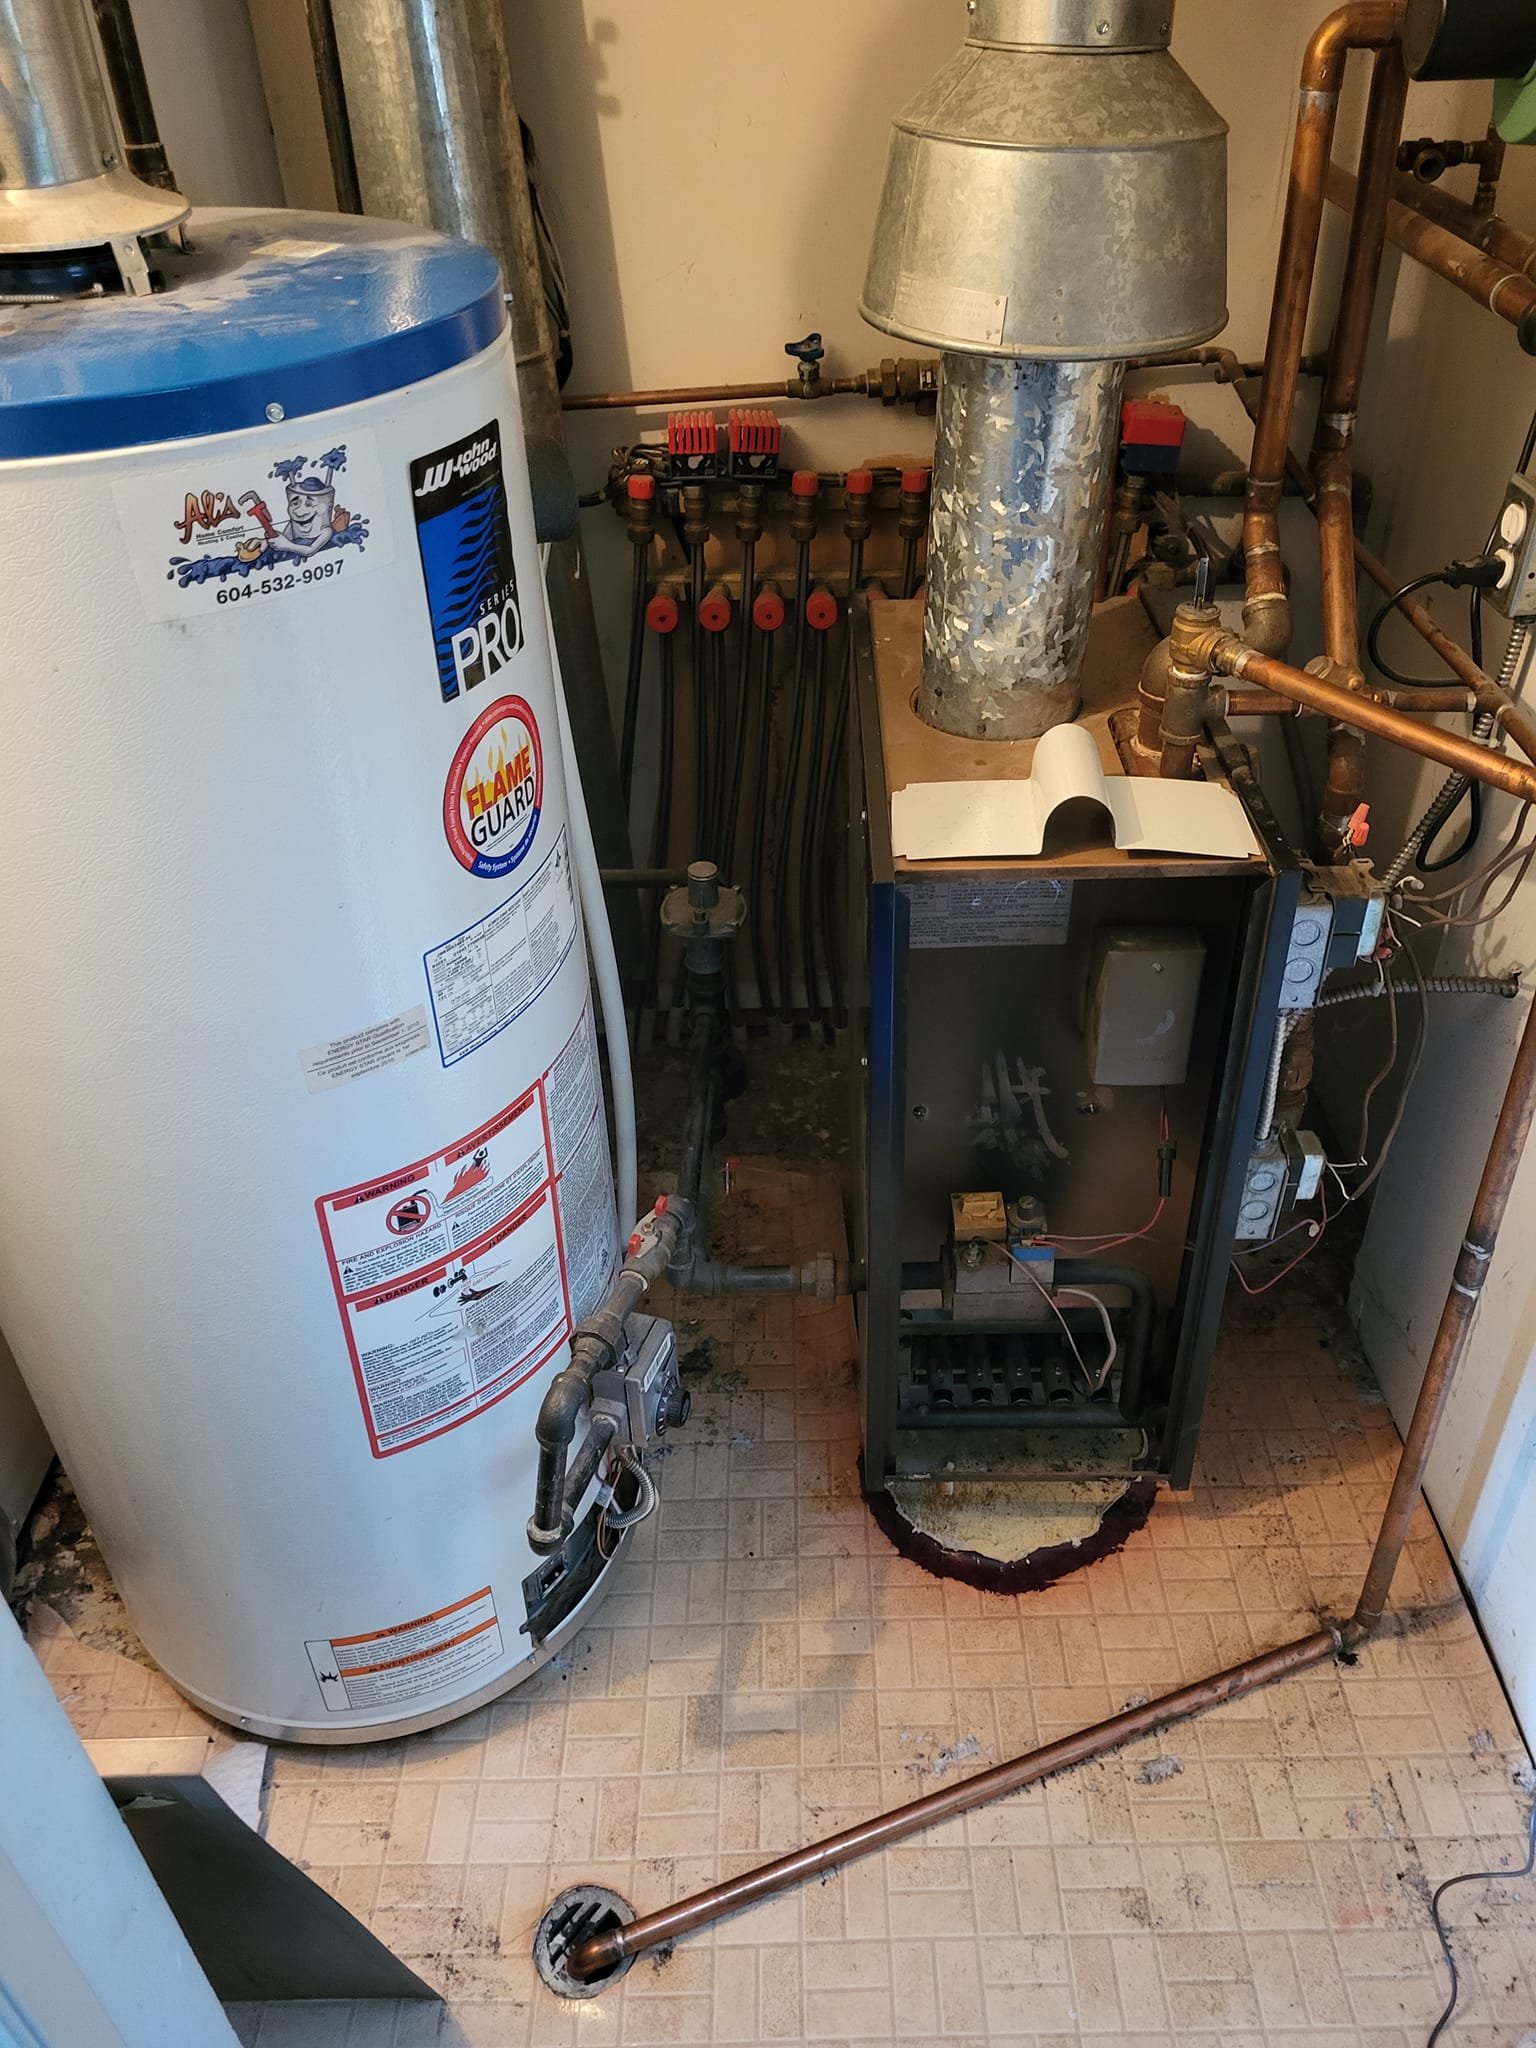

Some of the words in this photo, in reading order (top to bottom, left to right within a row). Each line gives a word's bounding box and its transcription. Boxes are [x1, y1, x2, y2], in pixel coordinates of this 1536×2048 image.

[173, 489, 241, 544] Al's
[196, 531, 215, 539] Home
[217, 525, 244, 535] Comfort
[216, 559, 344, 604] 604-532-9097
[480, 579, 515, 615] SERIES
[451, 598, 520, 695] PRO
[466, 745, 531, 820] FLAME
[471, 775, 535, 847] GUARD
[478, 861, 491, 873] Safety
[492, 861, 508, 872] System
[327, 1043, 354, 1056] ENERGY
[355, 1036, 372, 1045] STAR
[331, 1066, 358, 1079] ENERGY
[465, 1102, 528, 1151] AVERTISSEMENT
[364, 1174, 416, 1199] WARNING
[496, 1214, 526, 1242] DANGER
[341, 1257, 358, 1266] FIRE
[359, 1251, 375, 1260] AND
[376, 1236, 414, 1254] EXPLOSION
[415, 1223, 442, 1239] HAZARD
[385, 1277, 429, 1301] DANGER
[388, 1615, 434, 1635] WARNING
[380, 1639, 456, 1669] AVERTISSEMENT
